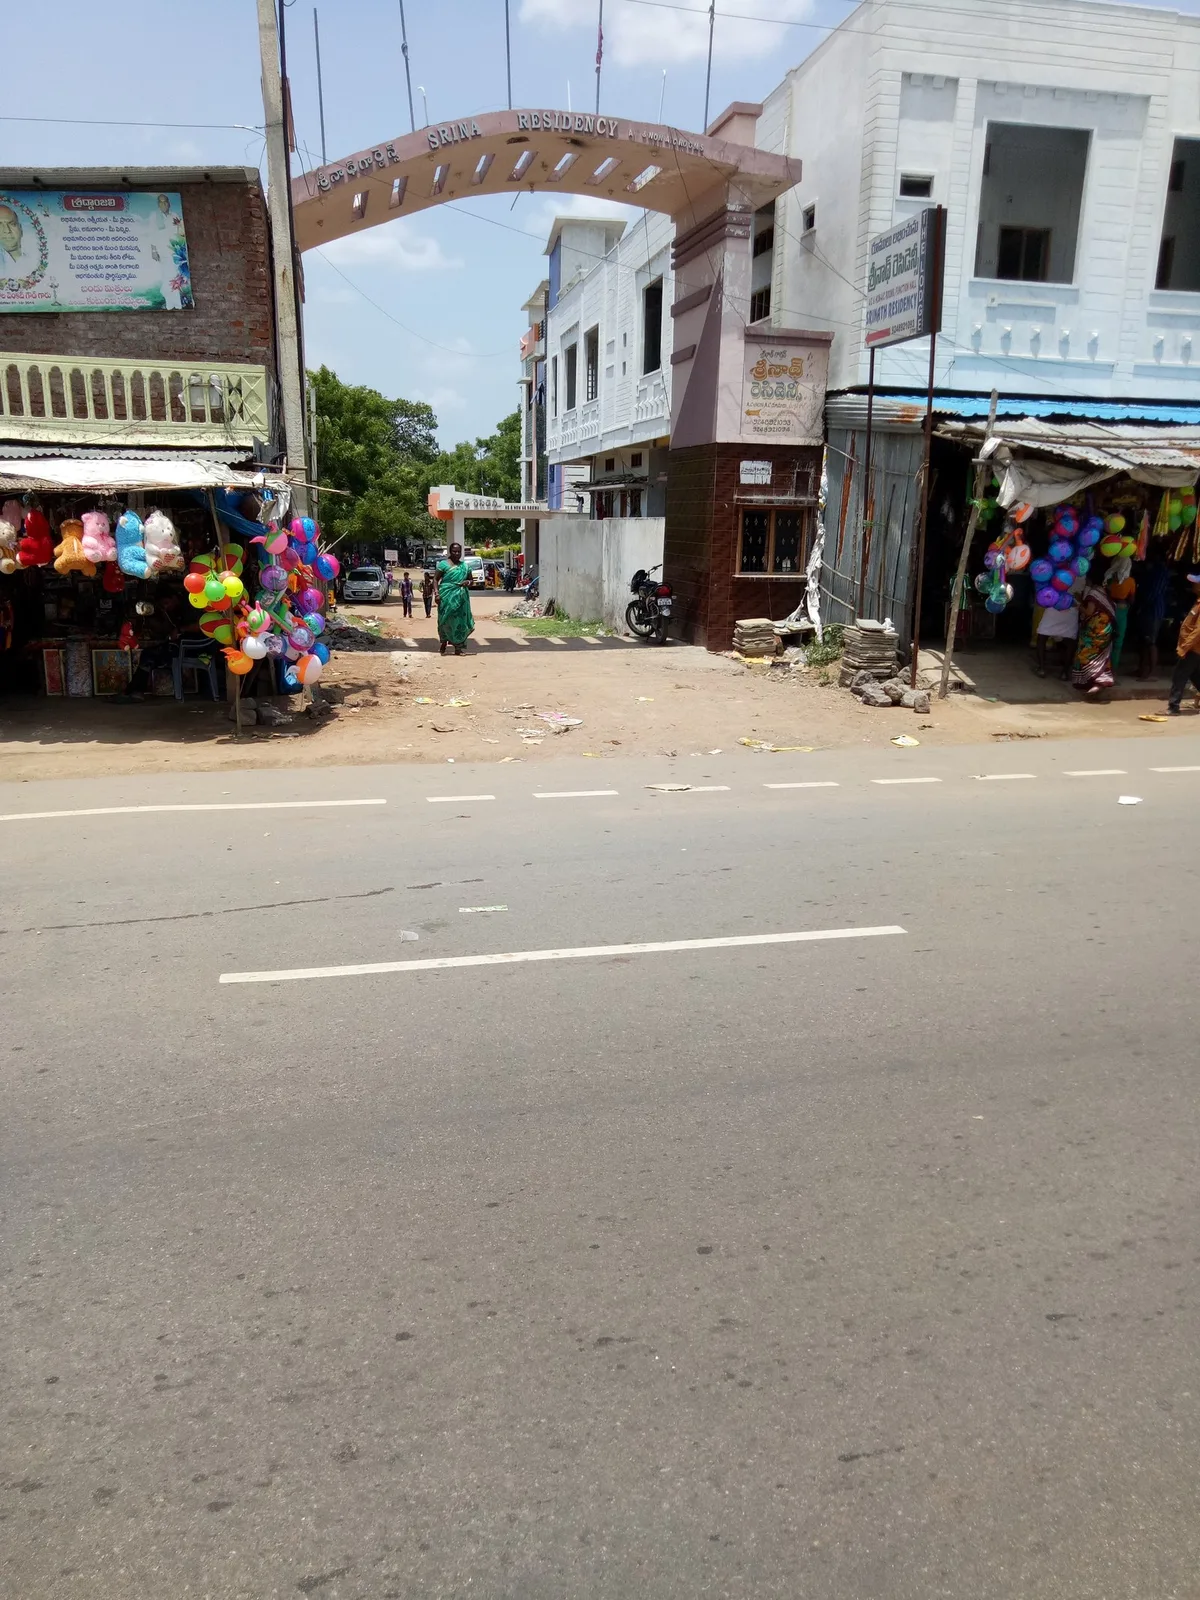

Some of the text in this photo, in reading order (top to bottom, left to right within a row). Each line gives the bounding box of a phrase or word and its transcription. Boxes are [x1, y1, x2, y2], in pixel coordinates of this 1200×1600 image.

[427, 111, 618, 149] SRINA RESIDENCY
[917, 260, 925, 333] LODGE
